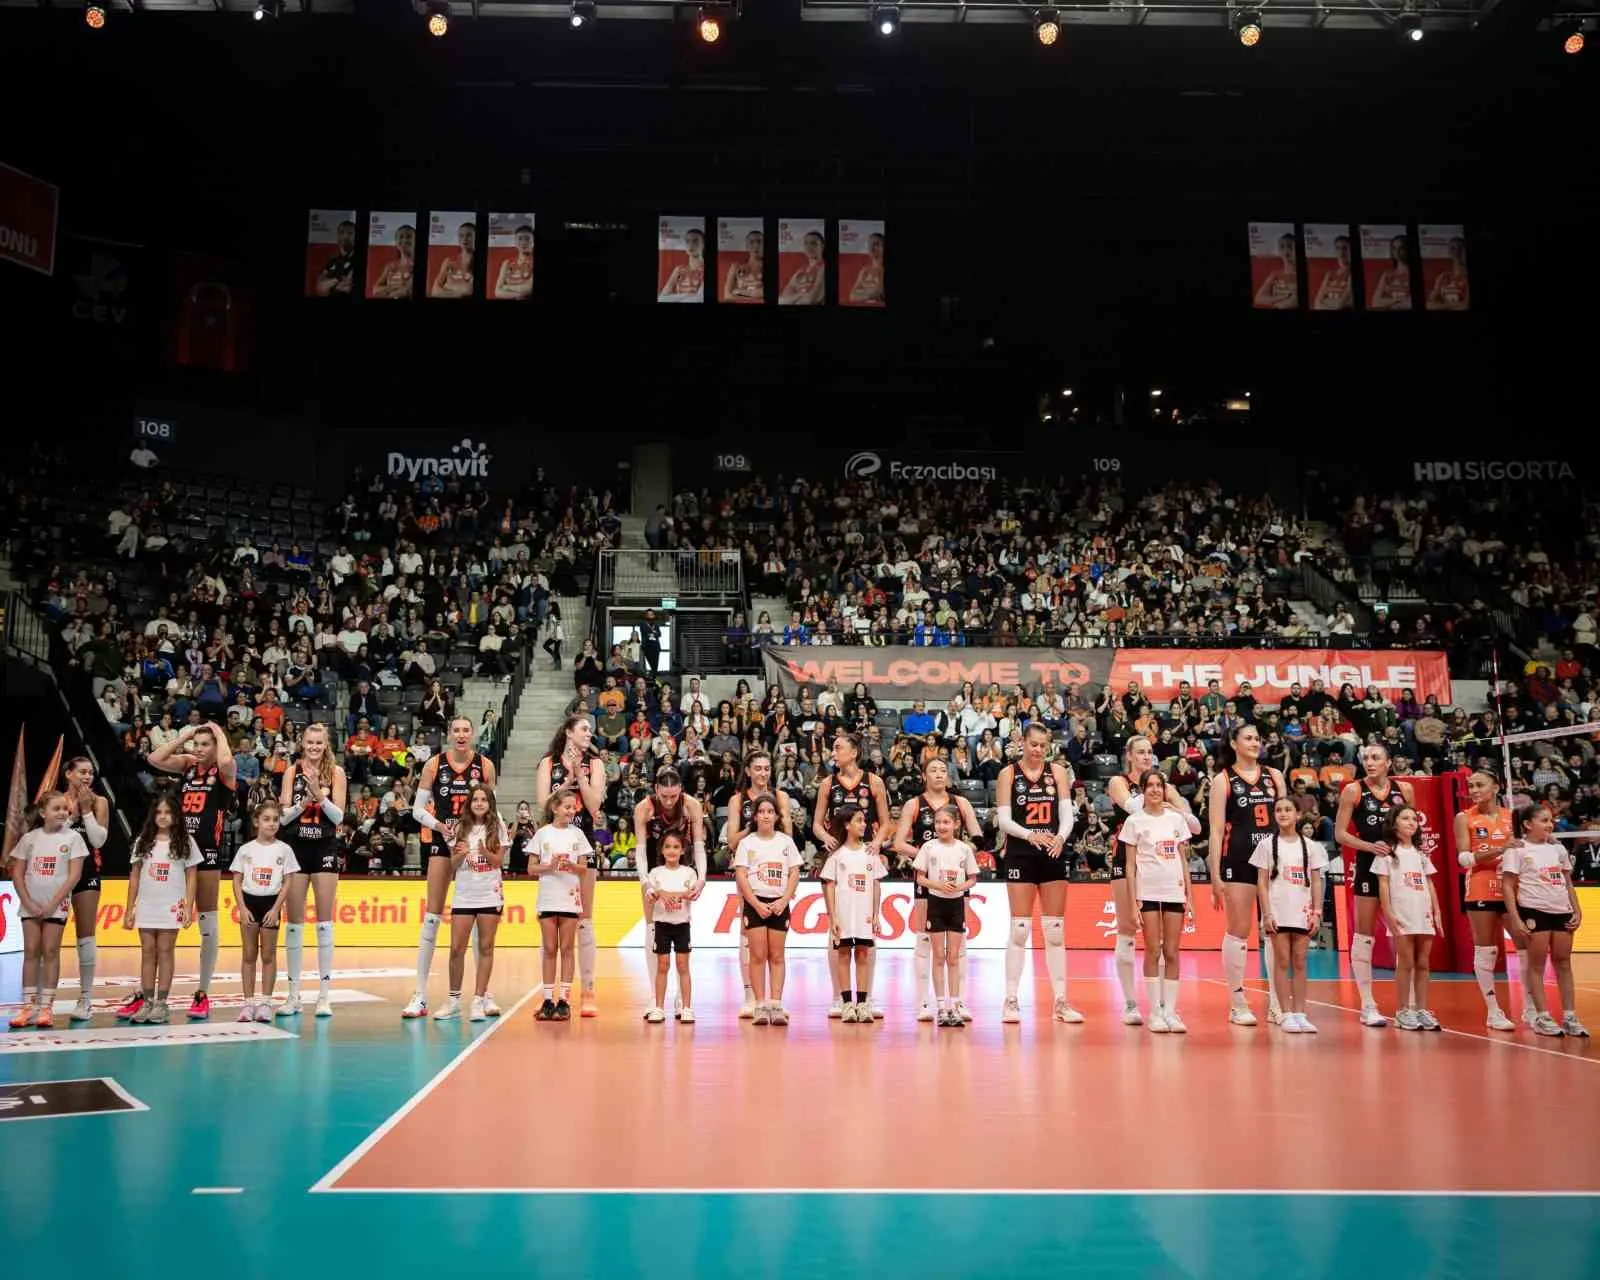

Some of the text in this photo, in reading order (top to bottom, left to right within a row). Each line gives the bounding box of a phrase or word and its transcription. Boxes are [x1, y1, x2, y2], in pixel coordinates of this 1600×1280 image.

[71, 300, 127, 324] CEV
[138, 420, 171, 437] 108
[387, 451, 489, 482] Dynavit
[717, 454, 745, 468] 109
[1093, 458, 1120, 471] 109
[786, 659, 1090, 686] WELCOME TO
[1130, 664, 1416, 689] THE JUNGLE
[182, 791, 208, 814] 99
[1025, 802, 1052, 825] 20
[1254, 804, 1270, 827] 9
[1008, 868, 1020, 880] 20
[1113, 867, 1123, 876] 15
[1225, 868, 1233, 879] 9
